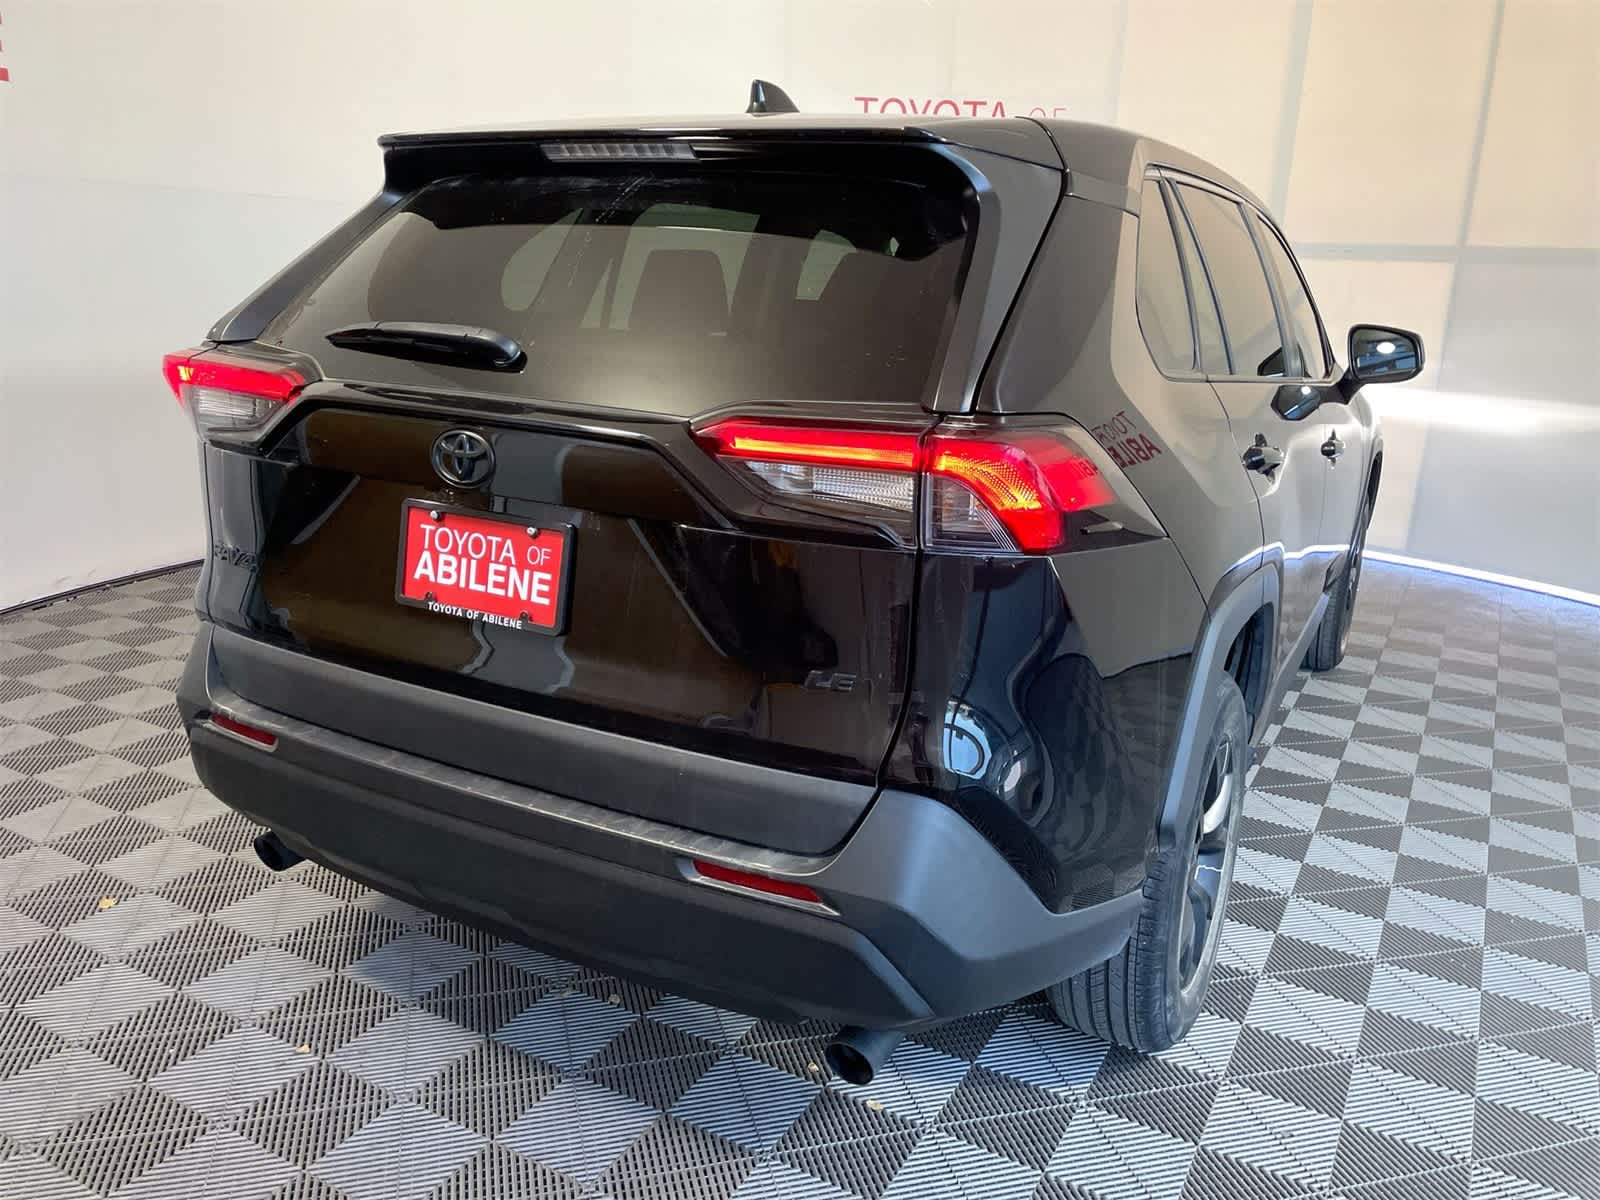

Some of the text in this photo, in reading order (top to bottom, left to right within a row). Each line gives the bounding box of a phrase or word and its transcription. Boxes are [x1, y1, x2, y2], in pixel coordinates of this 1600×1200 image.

[420, 523, 552, 566] TOYOTA OF
[413, 550, 552, 606] ABILENE
[428, 601, 523, 630] TOYOTA OF ABILENE
